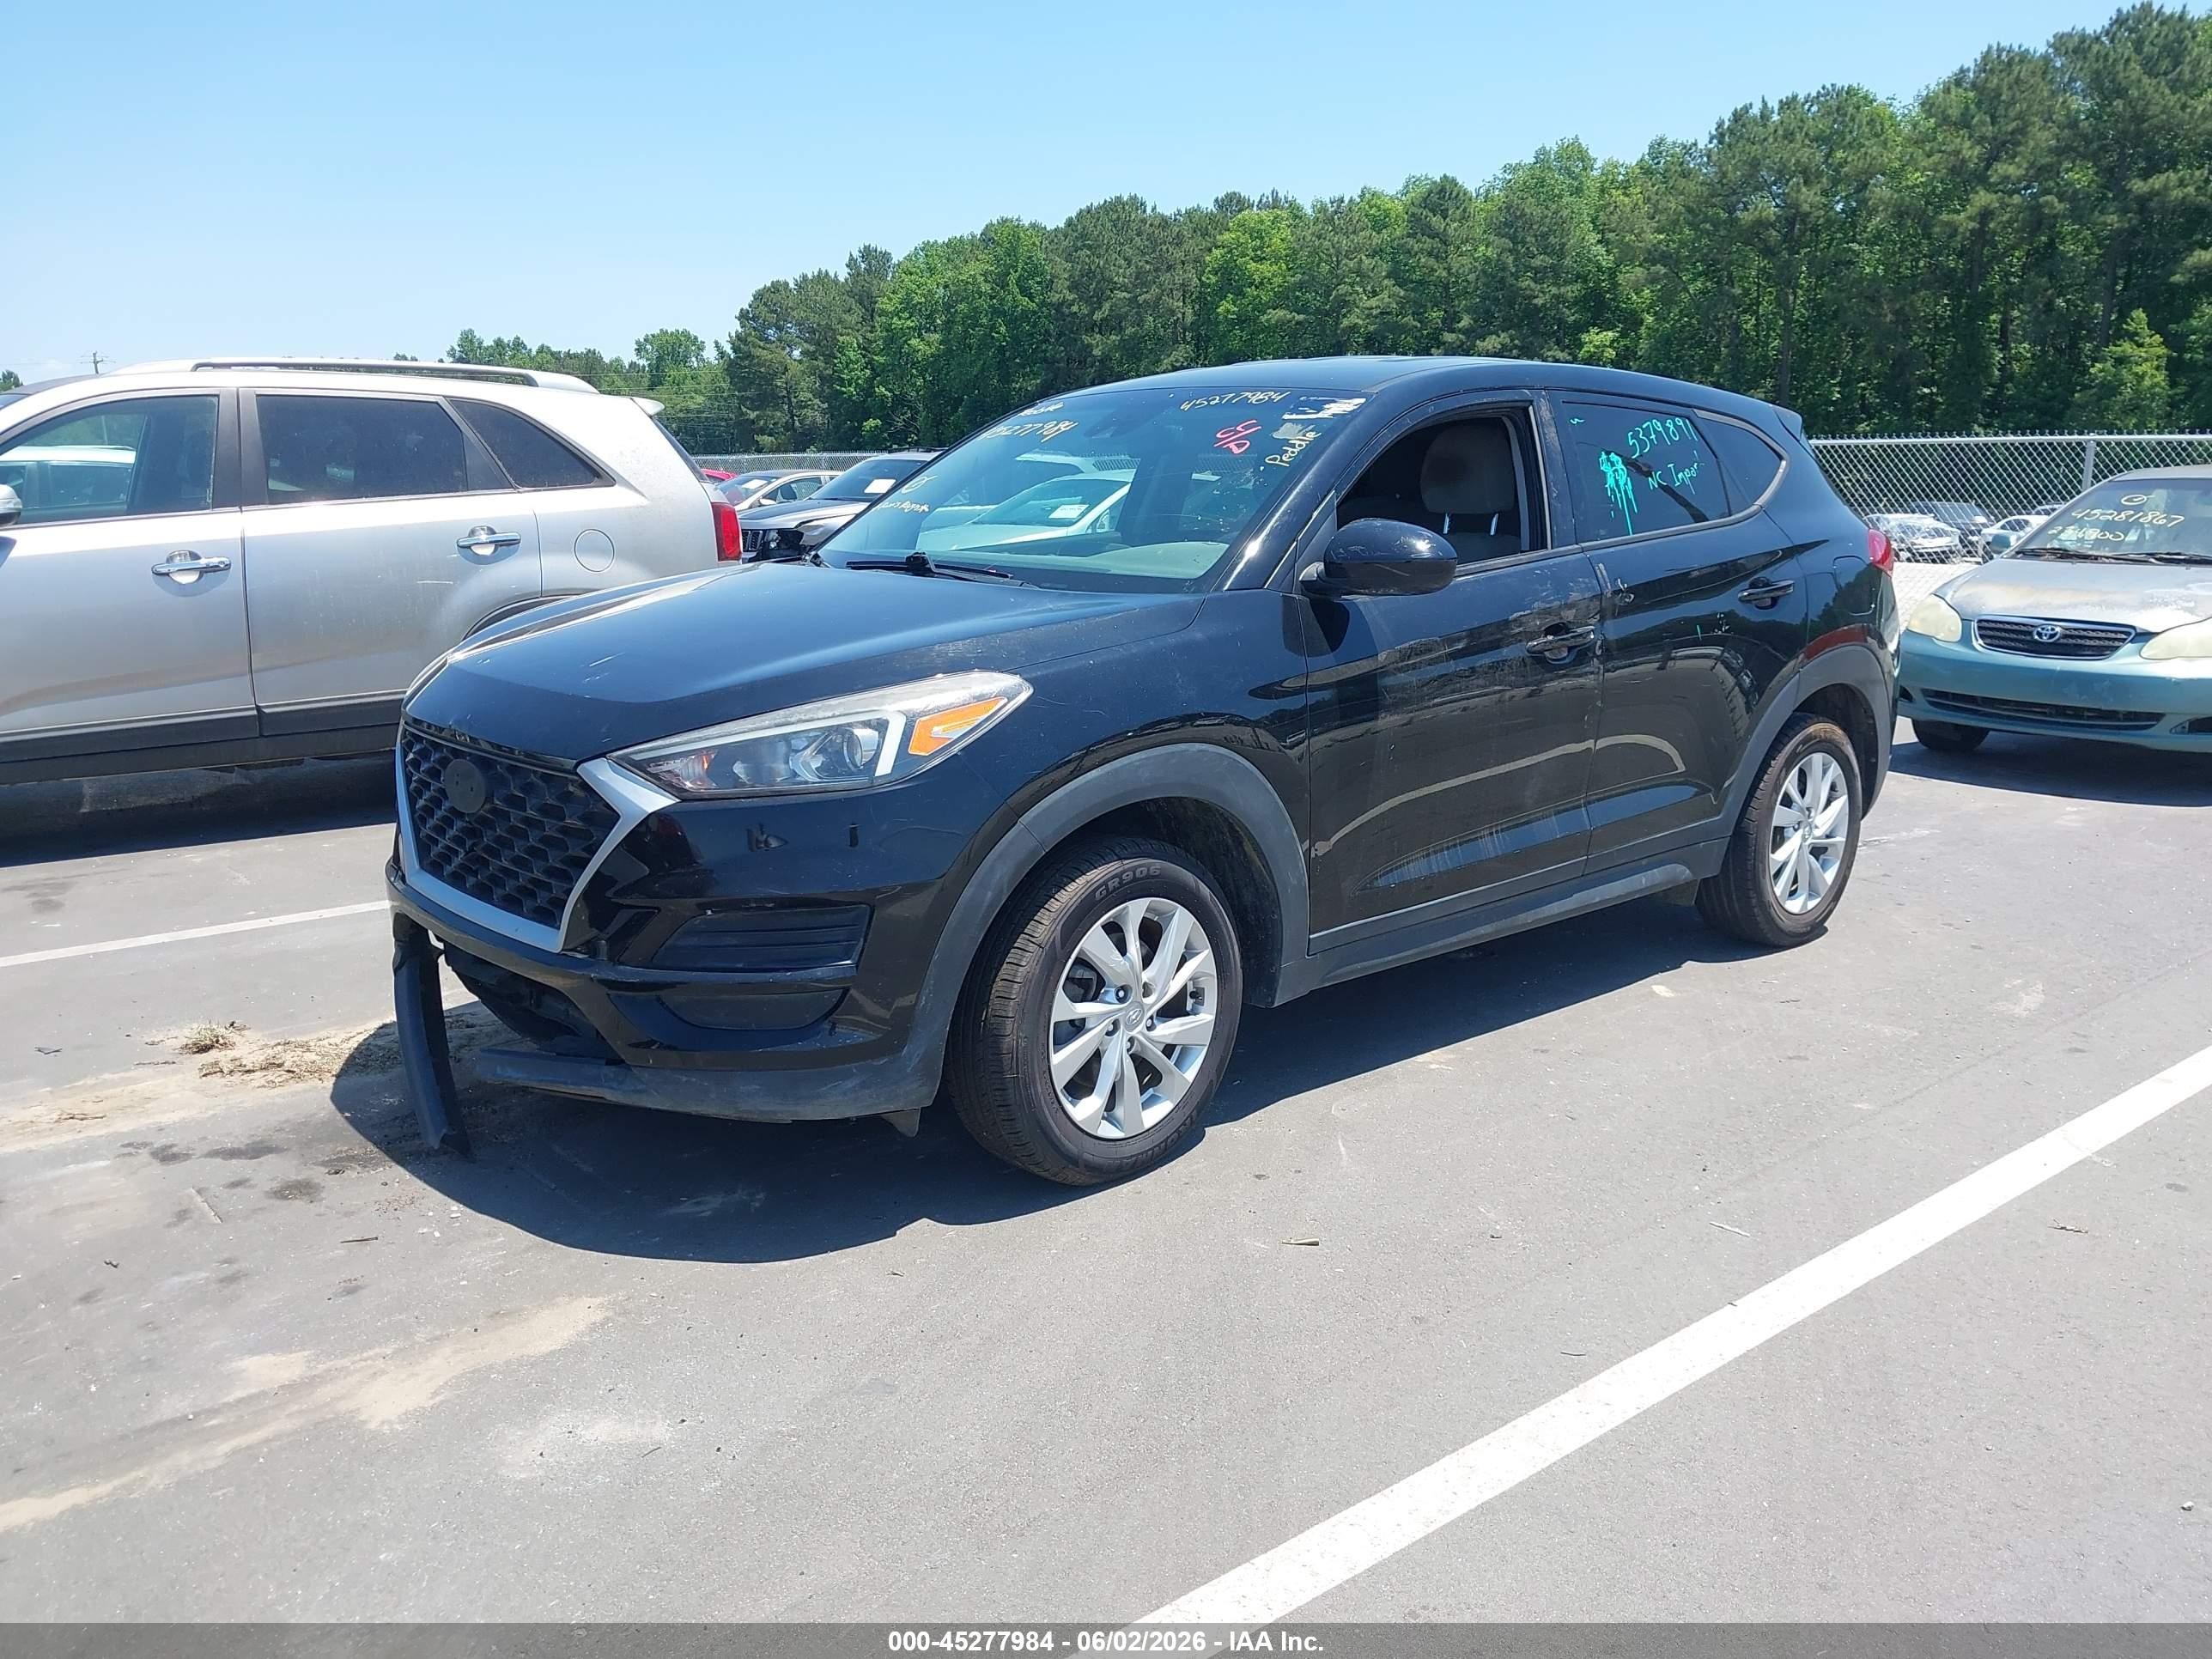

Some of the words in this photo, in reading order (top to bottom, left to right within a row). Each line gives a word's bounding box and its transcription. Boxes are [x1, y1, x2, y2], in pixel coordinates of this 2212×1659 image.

[1180, 392, 1291, 411] 45277984
[1265, 424, 1322, 467] Peddle
[1627, 417, 1698, 459] 5379891
[2071, 508, 2185, 527] 45281867
[1095, 866, 1162, 900] GR906
